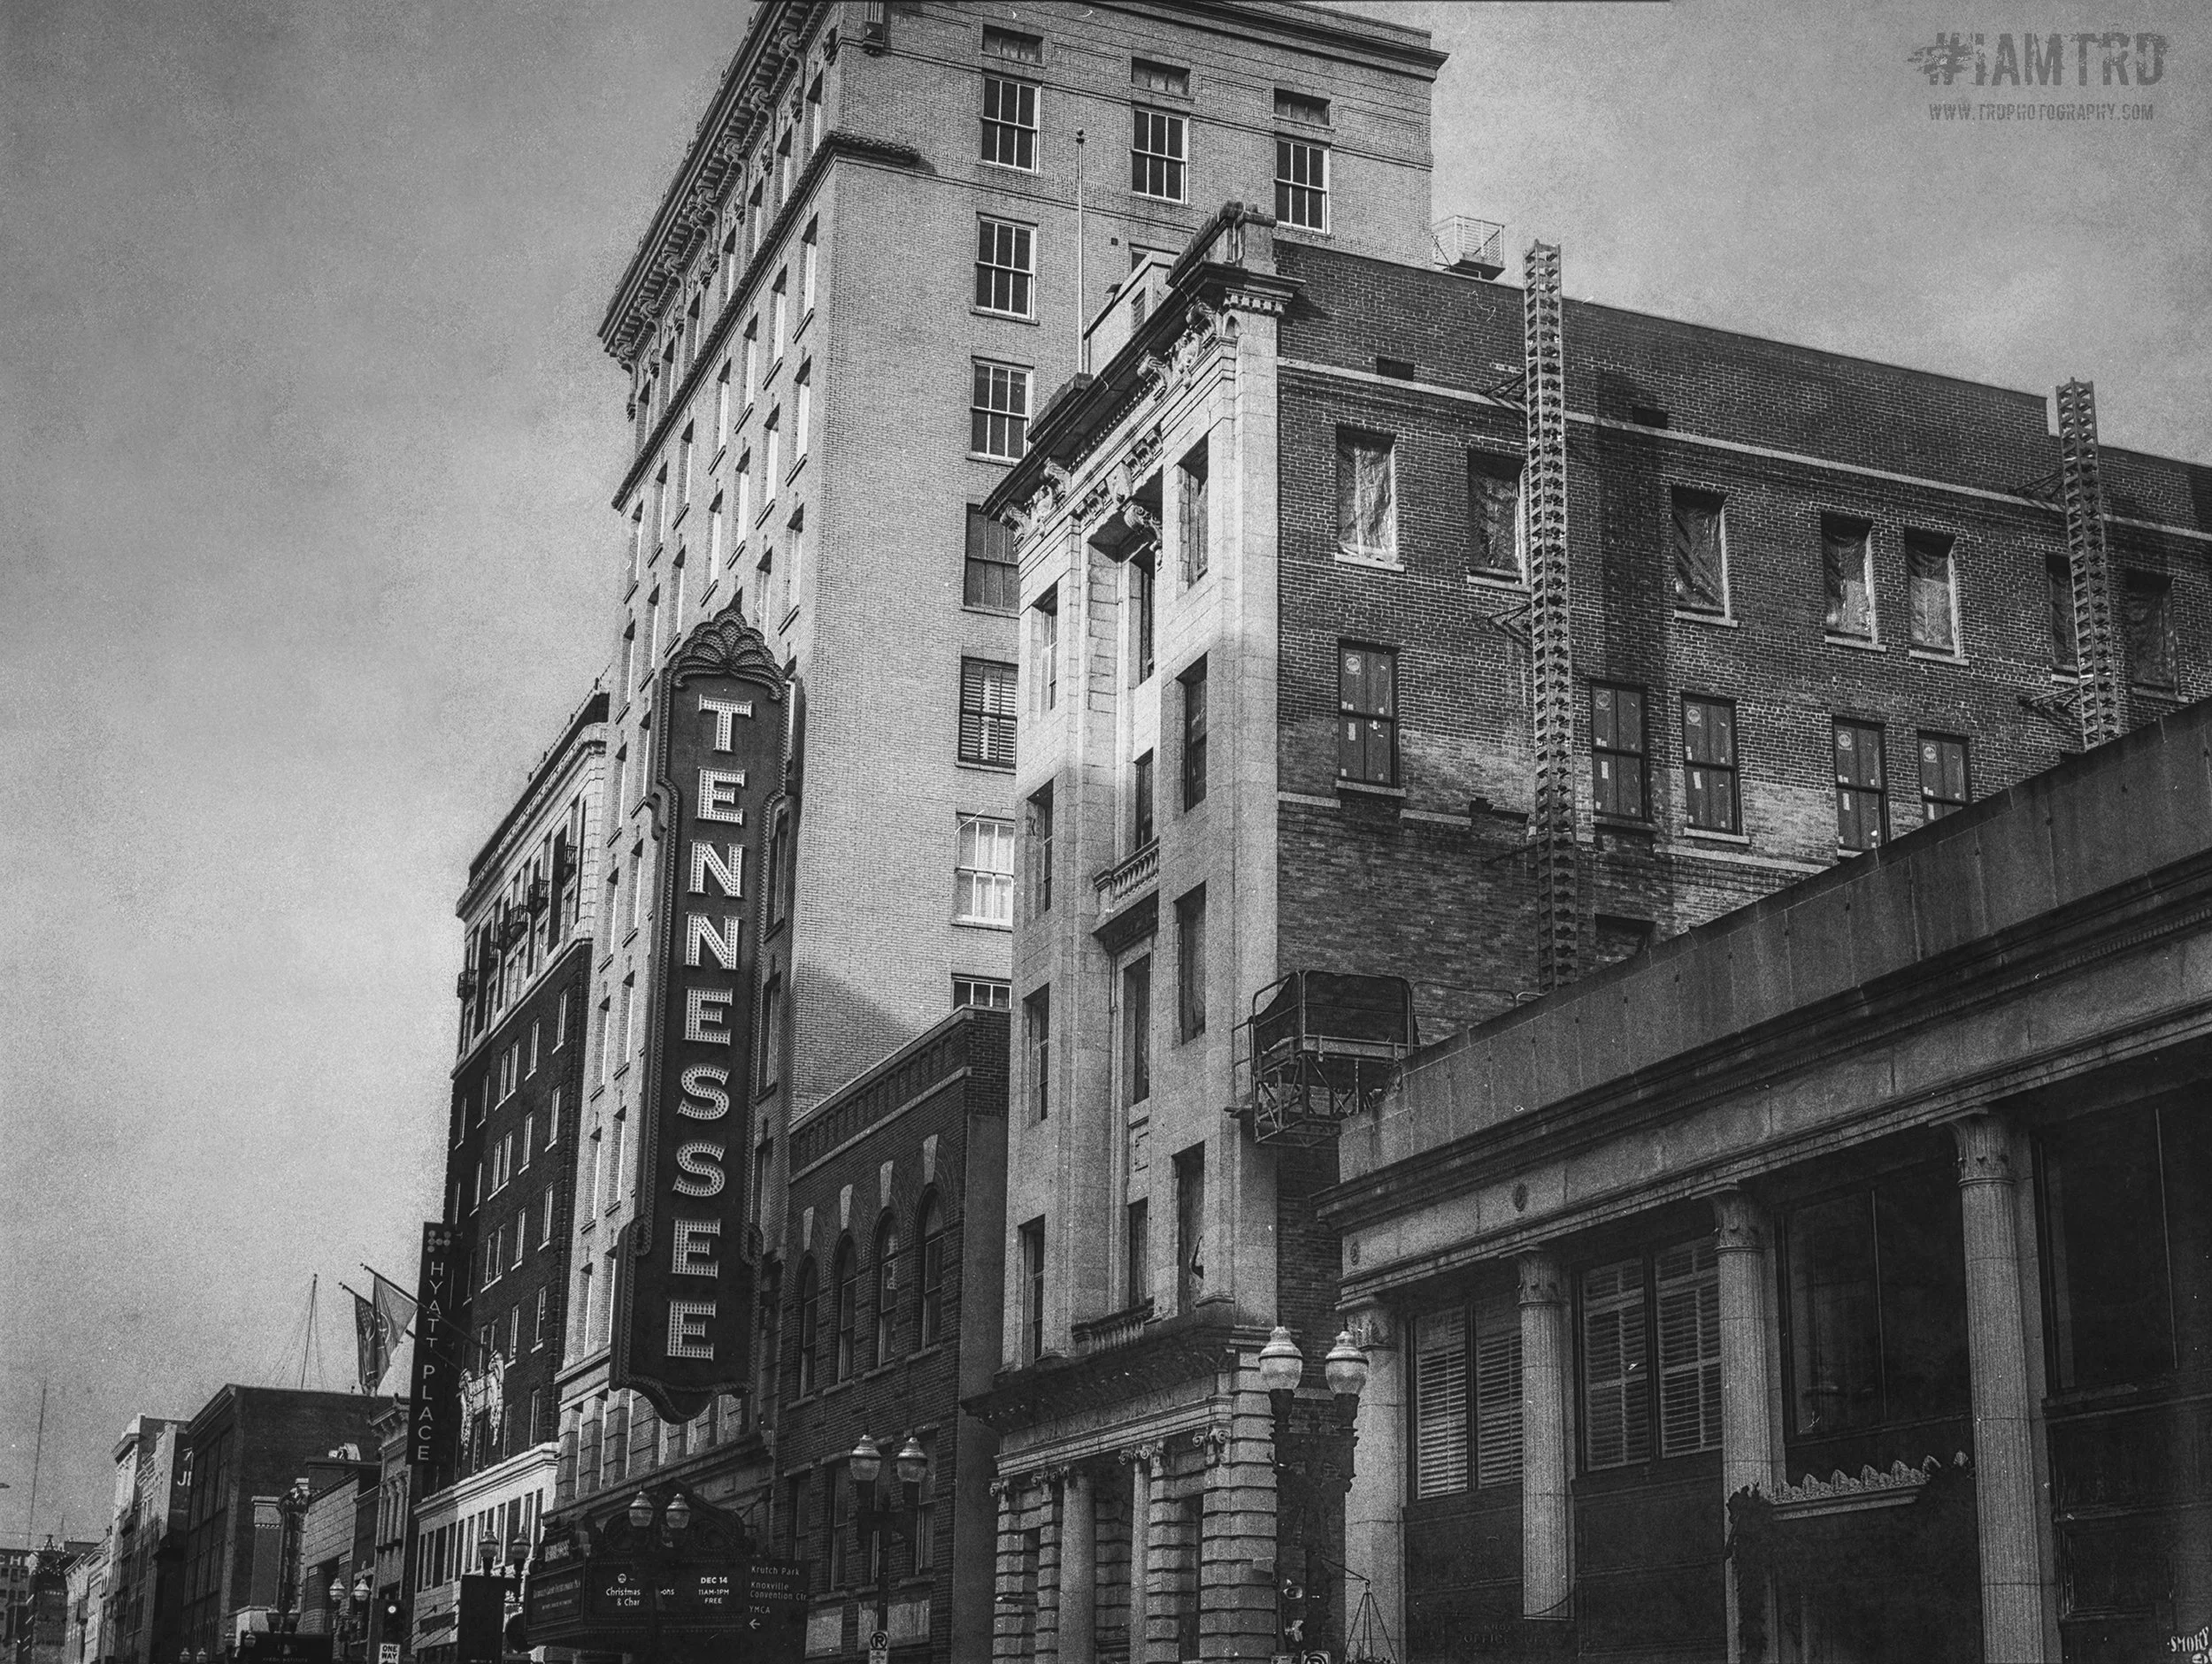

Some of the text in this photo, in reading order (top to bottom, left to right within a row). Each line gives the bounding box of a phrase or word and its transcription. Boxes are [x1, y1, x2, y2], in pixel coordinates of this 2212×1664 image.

[665, 694, 753, 1364] TENNESSEE
[426, 1261, 443, 1348] HYATT
[417, 1365, 435, 1461] PLACE
[751, 1565, 800, 1576] Krutch Park
[606, 1587, 641, 1596] Christmas
[750, 1582, 789, 1591] Knoxville
[749, 1590, 794, 1599] Convention
